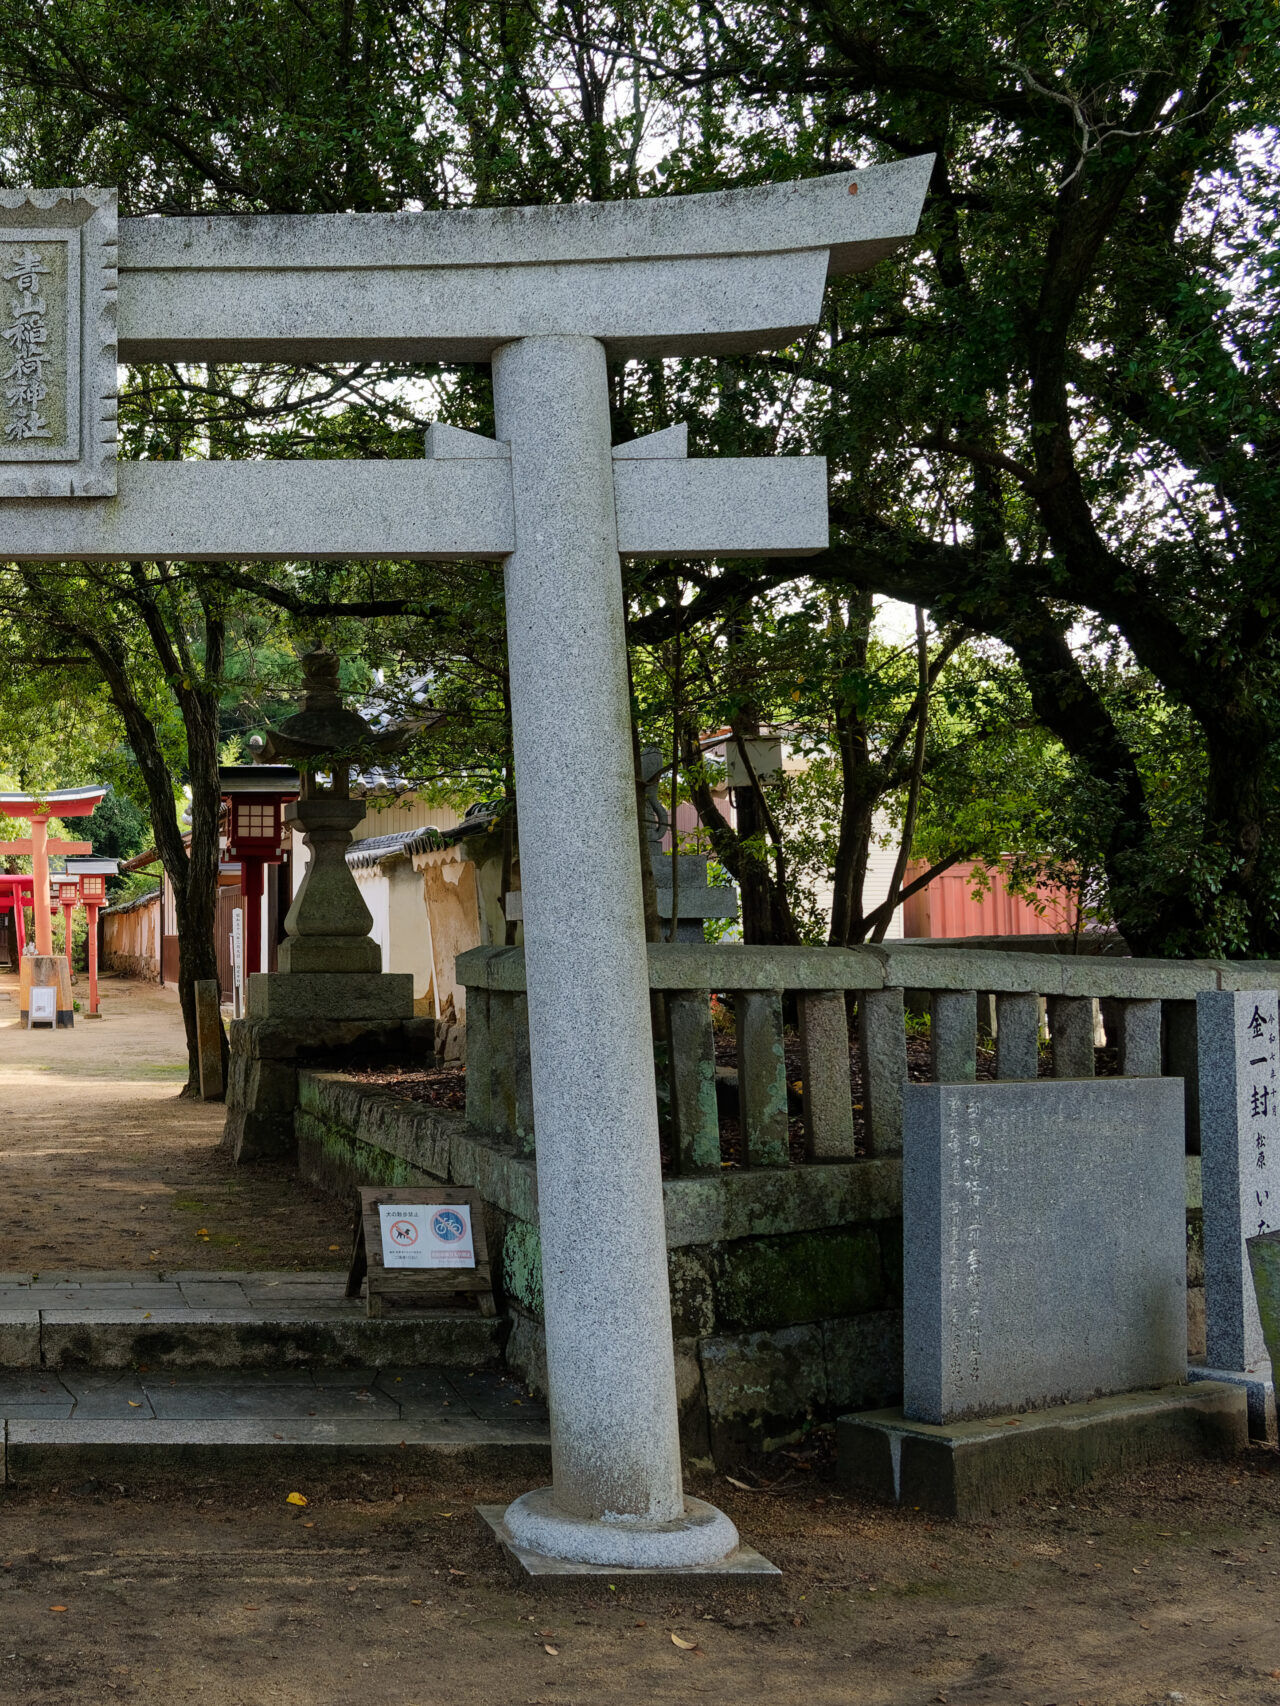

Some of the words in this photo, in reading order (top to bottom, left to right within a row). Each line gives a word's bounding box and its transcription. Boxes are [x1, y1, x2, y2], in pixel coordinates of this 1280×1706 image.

[0, 249, 53, 441] 青山稲荷神社
[1247, 1005, 1270, 1118] 金一封
[1256, 1132, 1267, 1169] 松原
